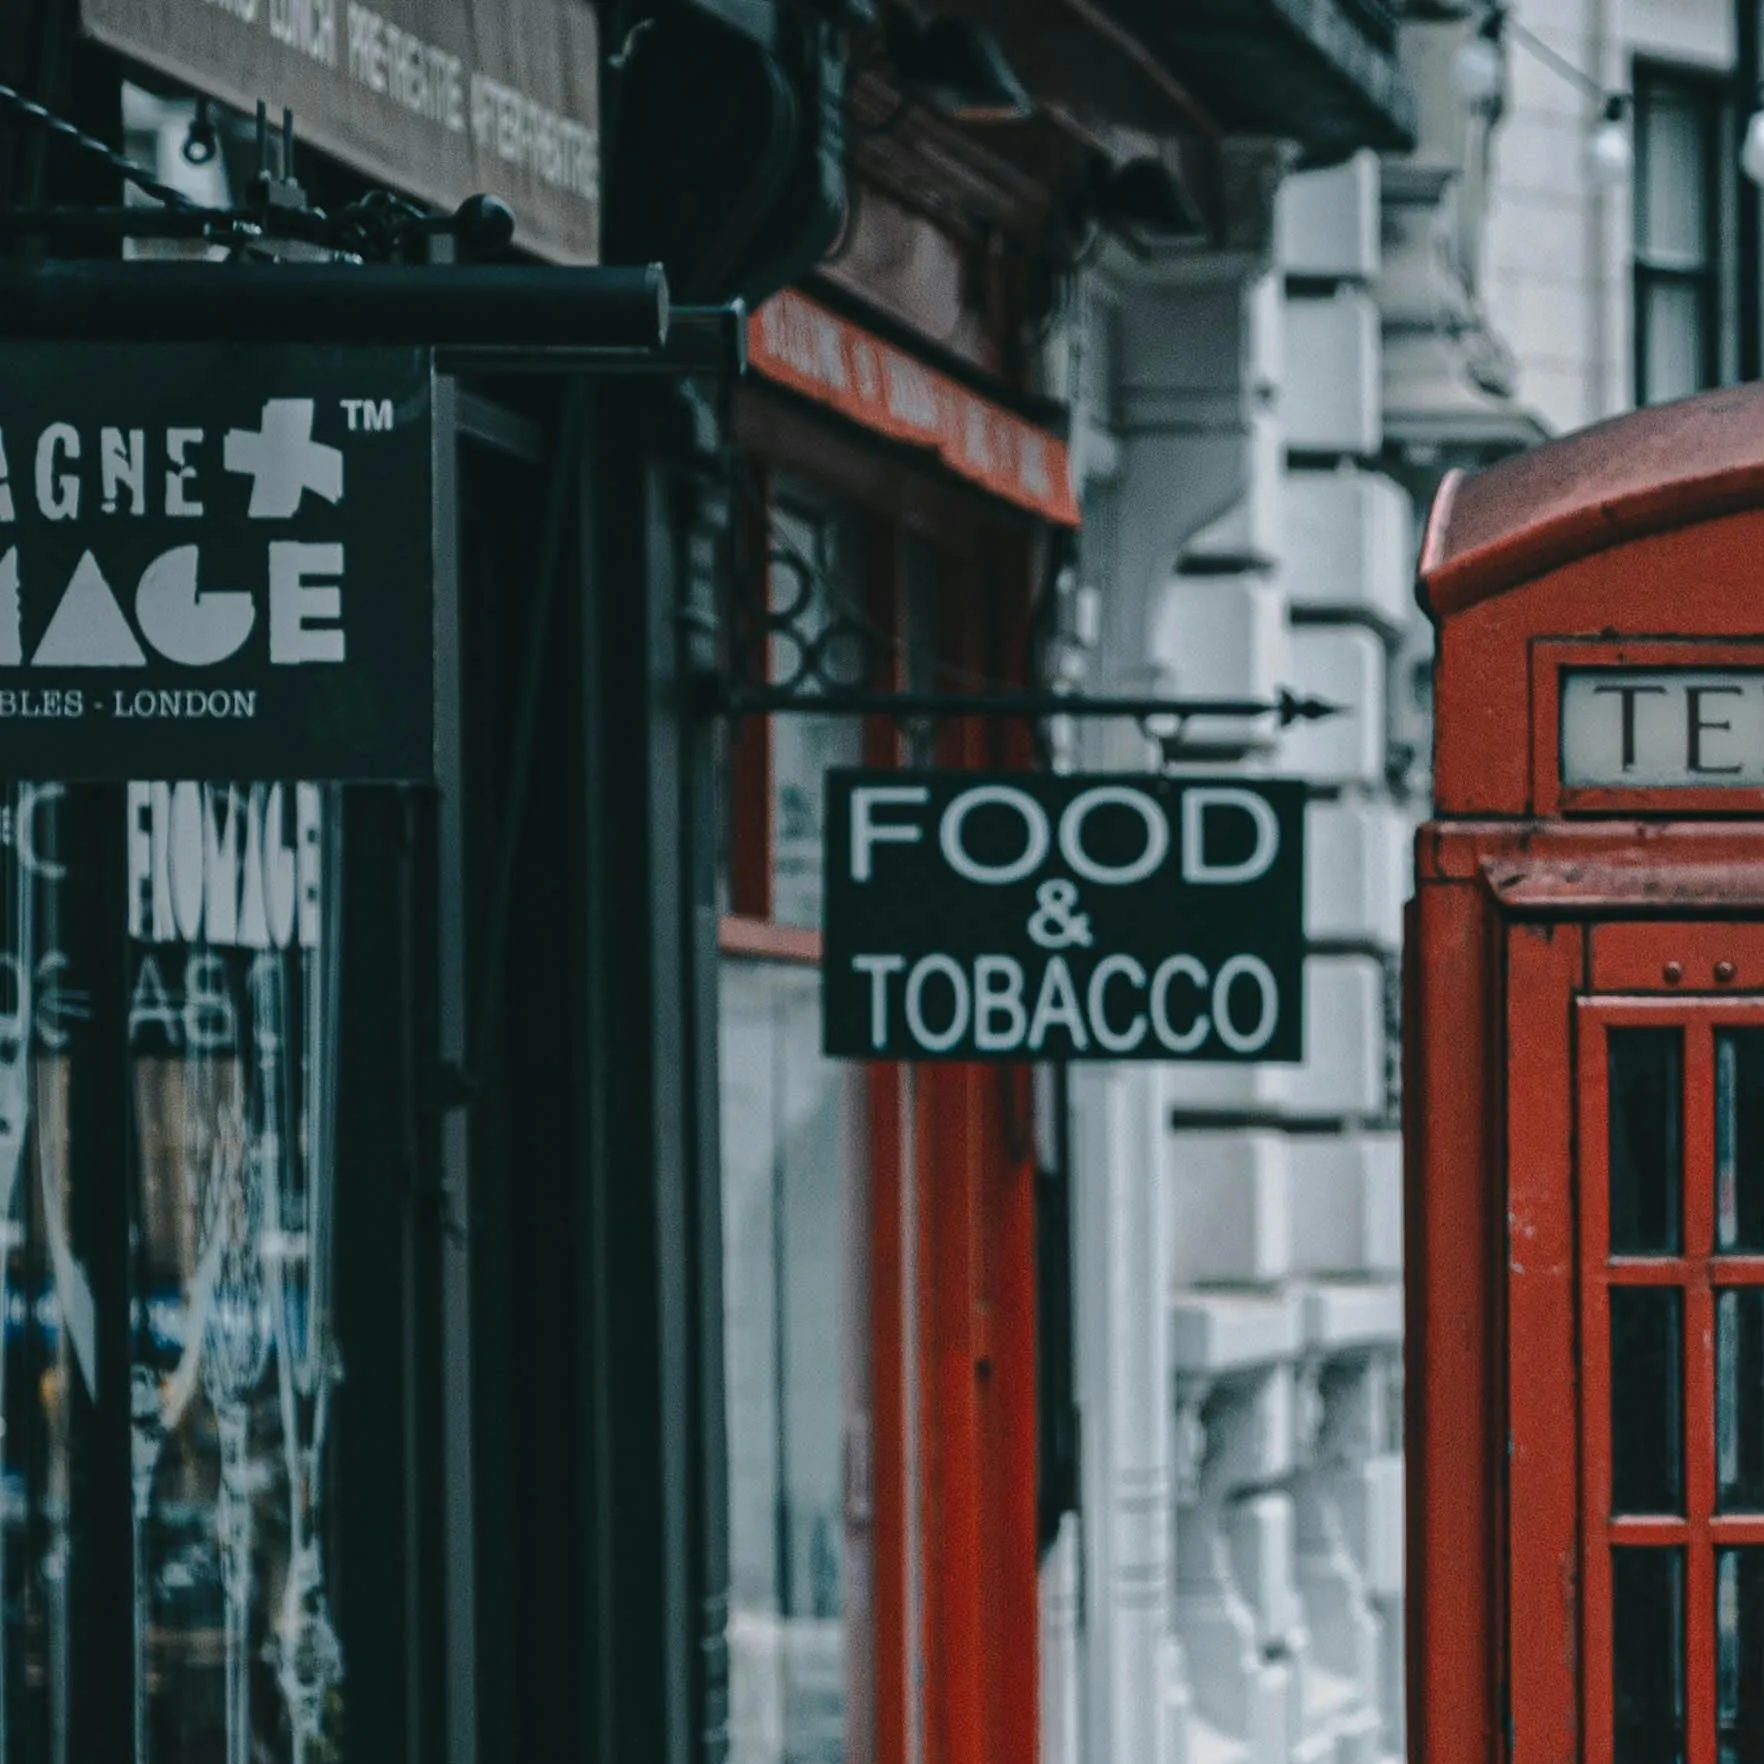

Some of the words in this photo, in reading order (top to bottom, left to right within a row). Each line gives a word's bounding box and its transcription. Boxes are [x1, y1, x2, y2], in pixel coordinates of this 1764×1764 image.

[0, 540, 346, 668] AGE
[113, 689, 257, 718] LONDON
[849, 785, 1281, 884] FOOD
[1027, 878, 1094, 948] &
[851, 953, 1279, 1052] TOBACCO
